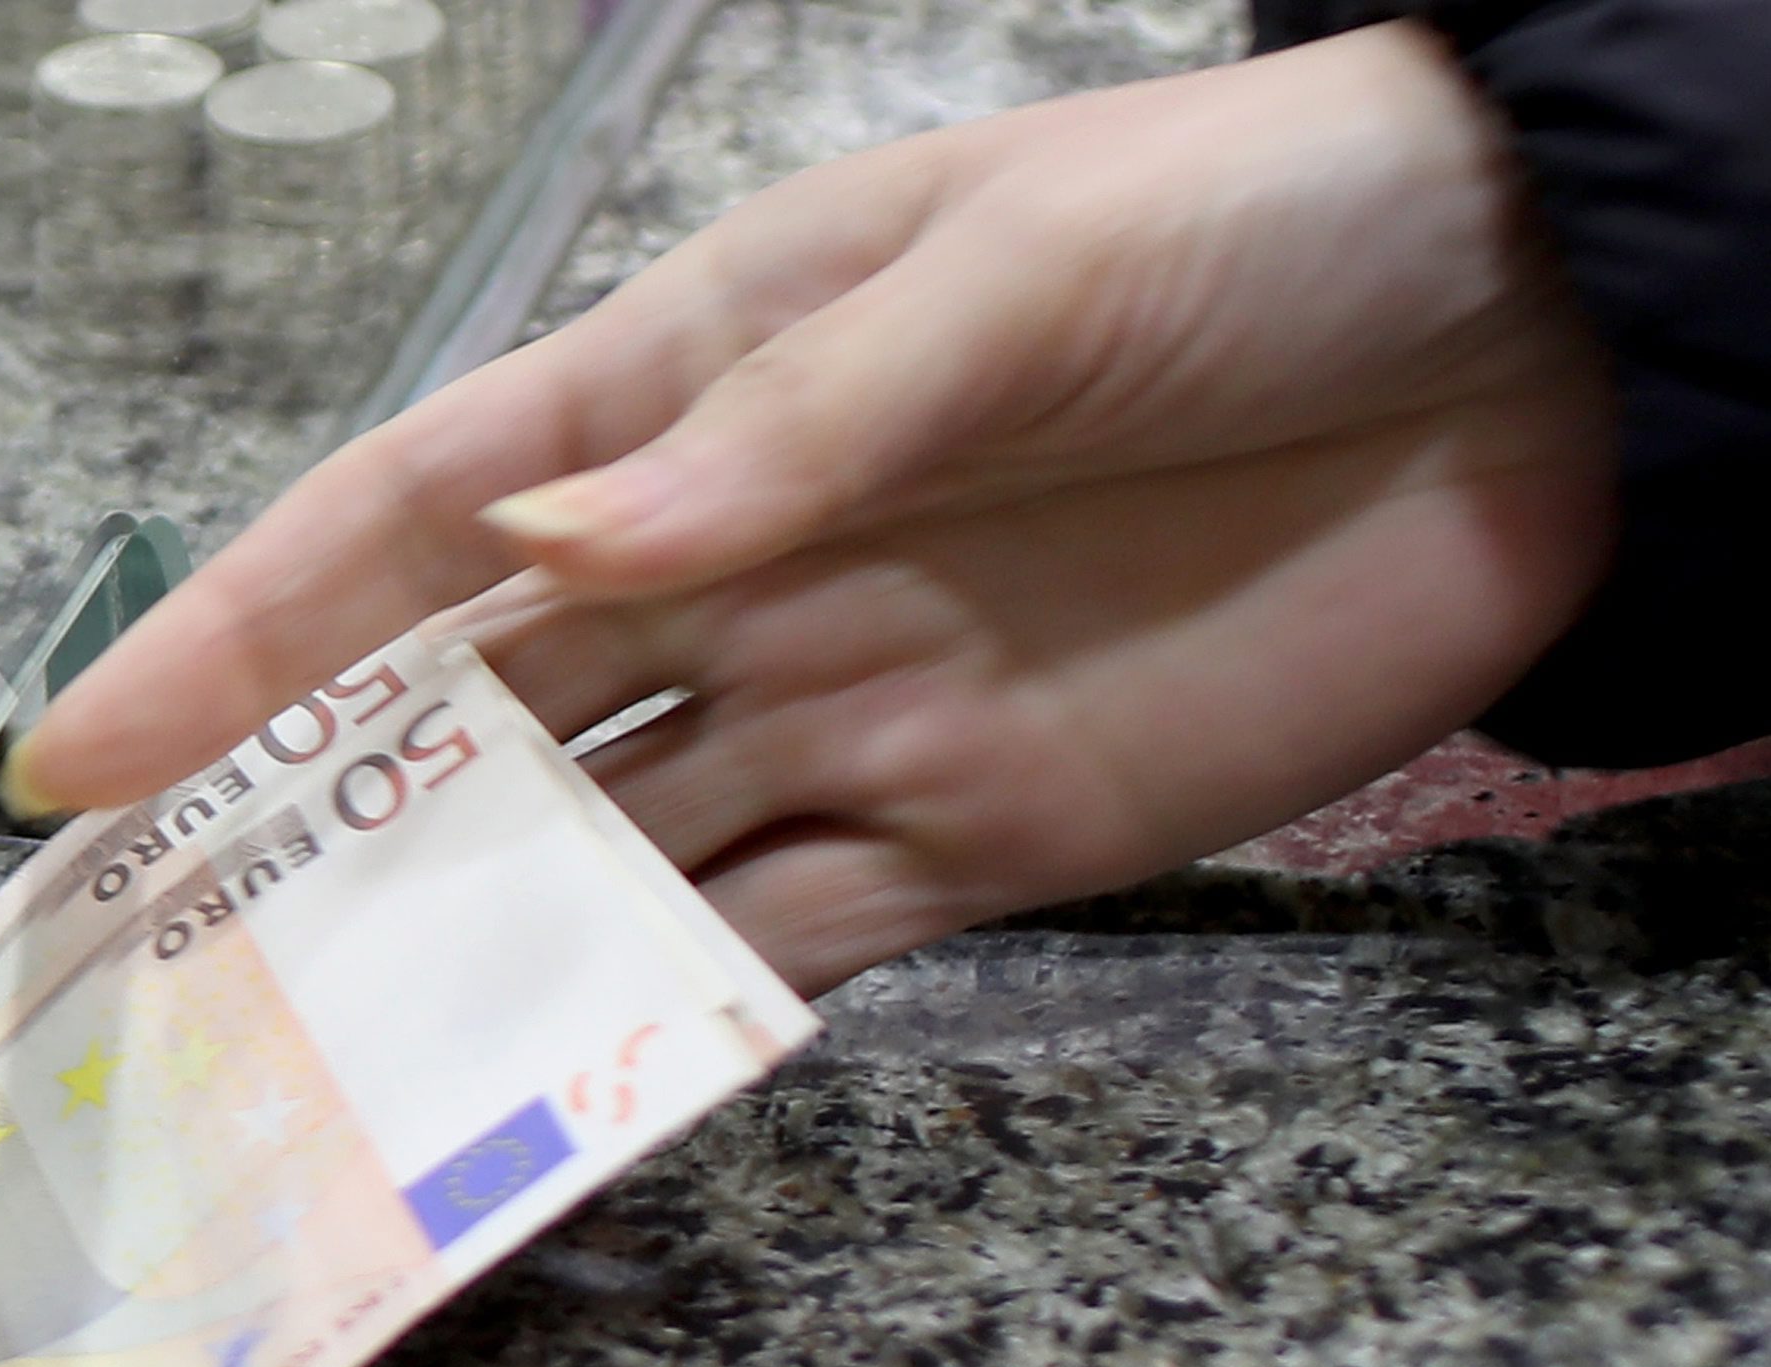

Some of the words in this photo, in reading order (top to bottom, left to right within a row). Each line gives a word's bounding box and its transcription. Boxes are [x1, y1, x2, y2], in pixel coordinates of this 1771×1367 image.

[258, 663, 408, 764] 50
[335, 701, 479, 830] 50
[94, 768, 255, 901] EURO
[156, 831, 324, 959] EURO
